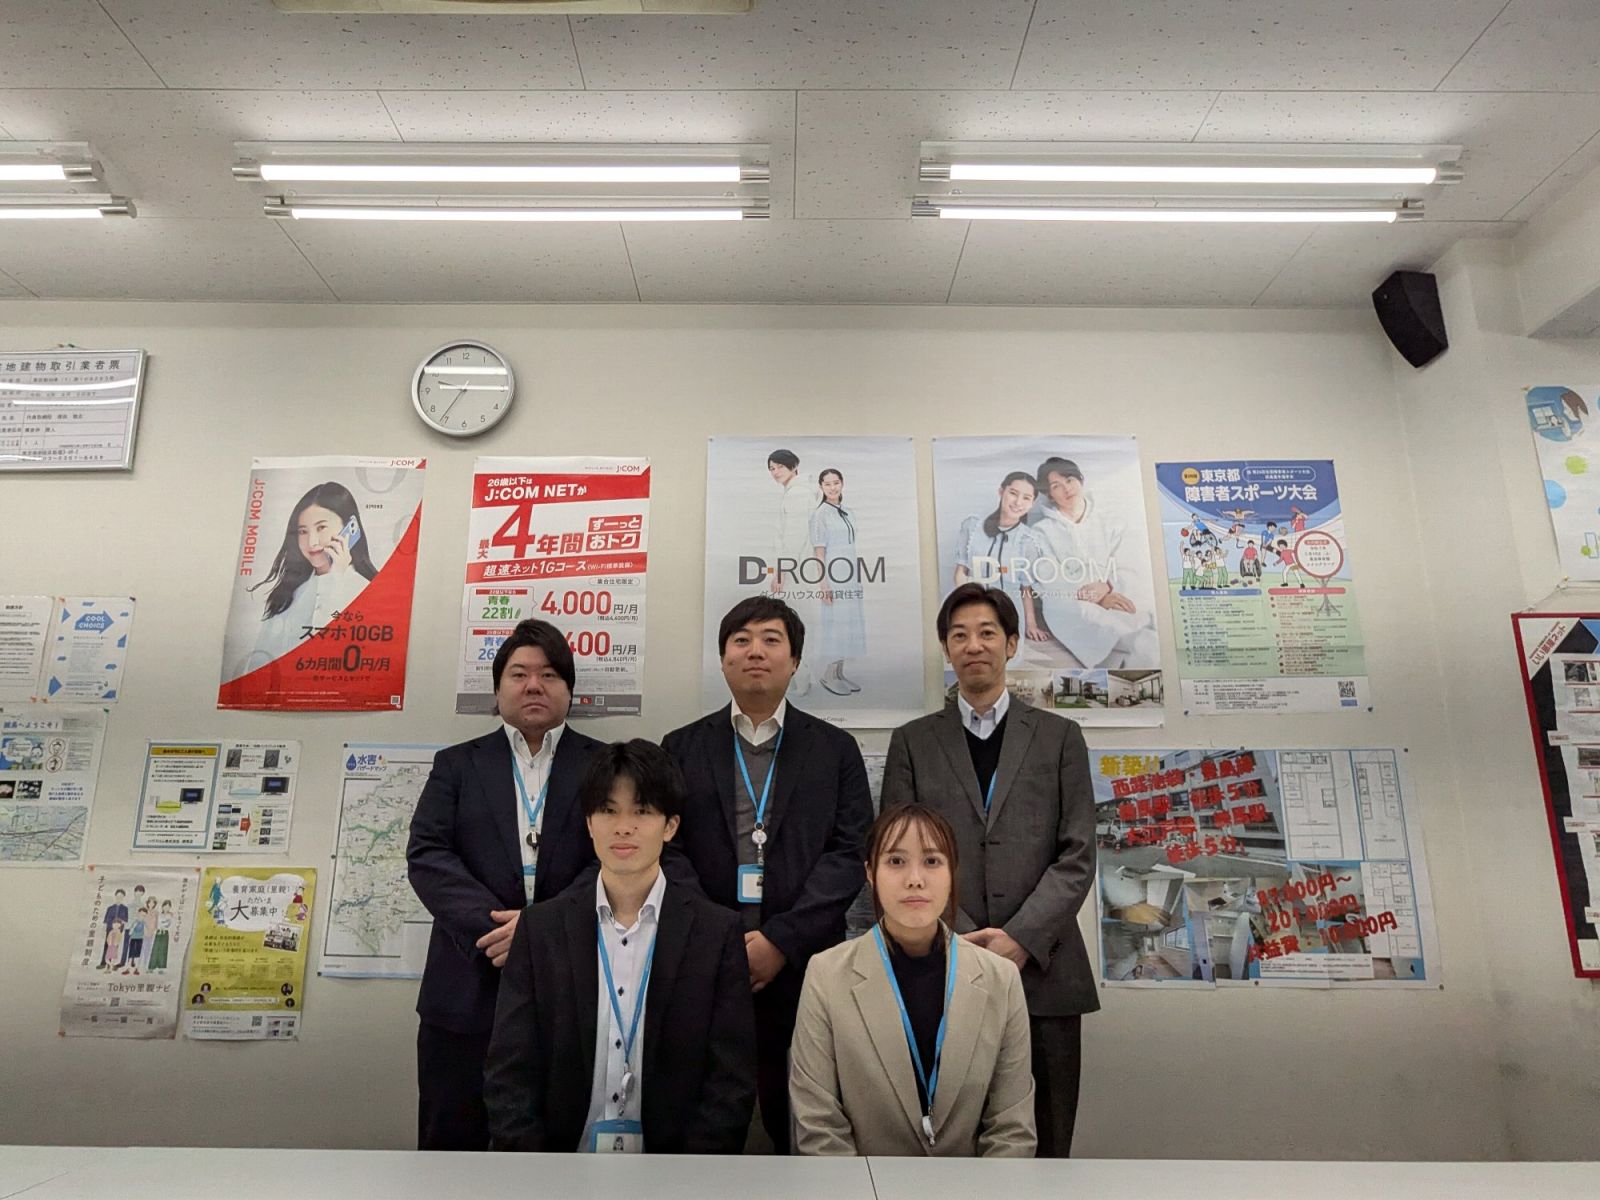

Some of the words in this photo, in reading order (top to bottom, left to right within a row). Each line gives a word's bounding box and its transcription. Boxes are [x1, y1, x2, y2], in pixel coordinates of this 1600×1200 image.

[462, 352, 470, 360] 12
[0, 360, 121, 372] 地建物取引業者票
[461, 420, 467, 428] 6
[480, 415, 486, 423] 5
[616, 465, 640, 473] J:COM
[1201, 468, 1241, 483] 東京都
[487, 477, 533, 487] 26歳以下は
[484, 486, 539, 501] J:COM
[543, 484, 587, 498] NETが
[1185, 484, 1318, 502] 障害者スポーツ大会
[248, 478, 266, 520] J:COM
[592, 517, 640, 531] ずーっと
[589, 533, 637, 550] おトク
[239, 525, 259, 576] MOBILE
[488, 595, 510, 606] 青春
[331, 610, 364, 622] 今なら
[478, 648, 497, 660] 26
[357, 754, 377, 766] 水害
